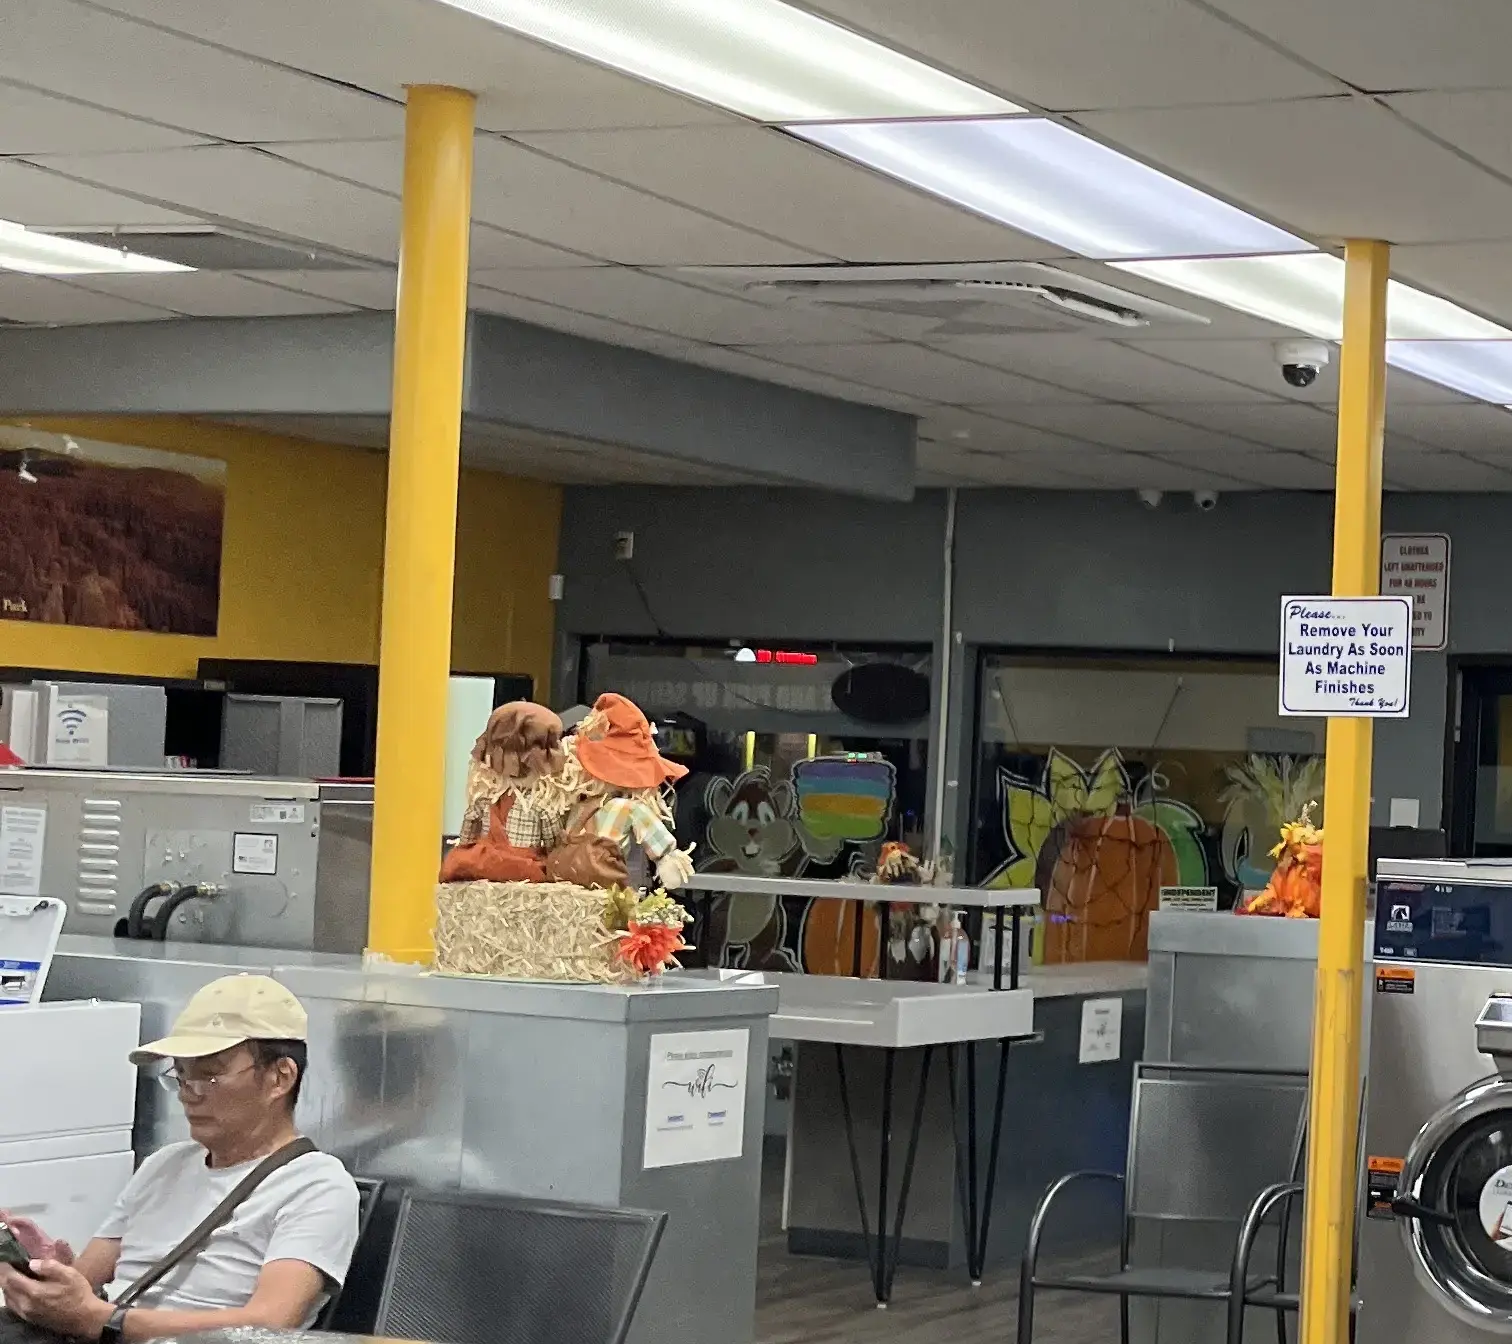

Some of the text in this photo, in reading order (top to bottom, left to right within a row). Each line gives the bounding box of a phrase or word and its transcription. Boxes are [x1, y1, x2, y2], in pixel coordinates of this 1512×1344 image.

[1300, 623, 1394, 637] Remove Your
[1288, 642, 1404, 659] Laundry As Soon
[1305, 661, 1386, 675] As Machine
[1315, 679, 1375, 694] Finishes
[1349, 697, 1399, 709] Thank You!
